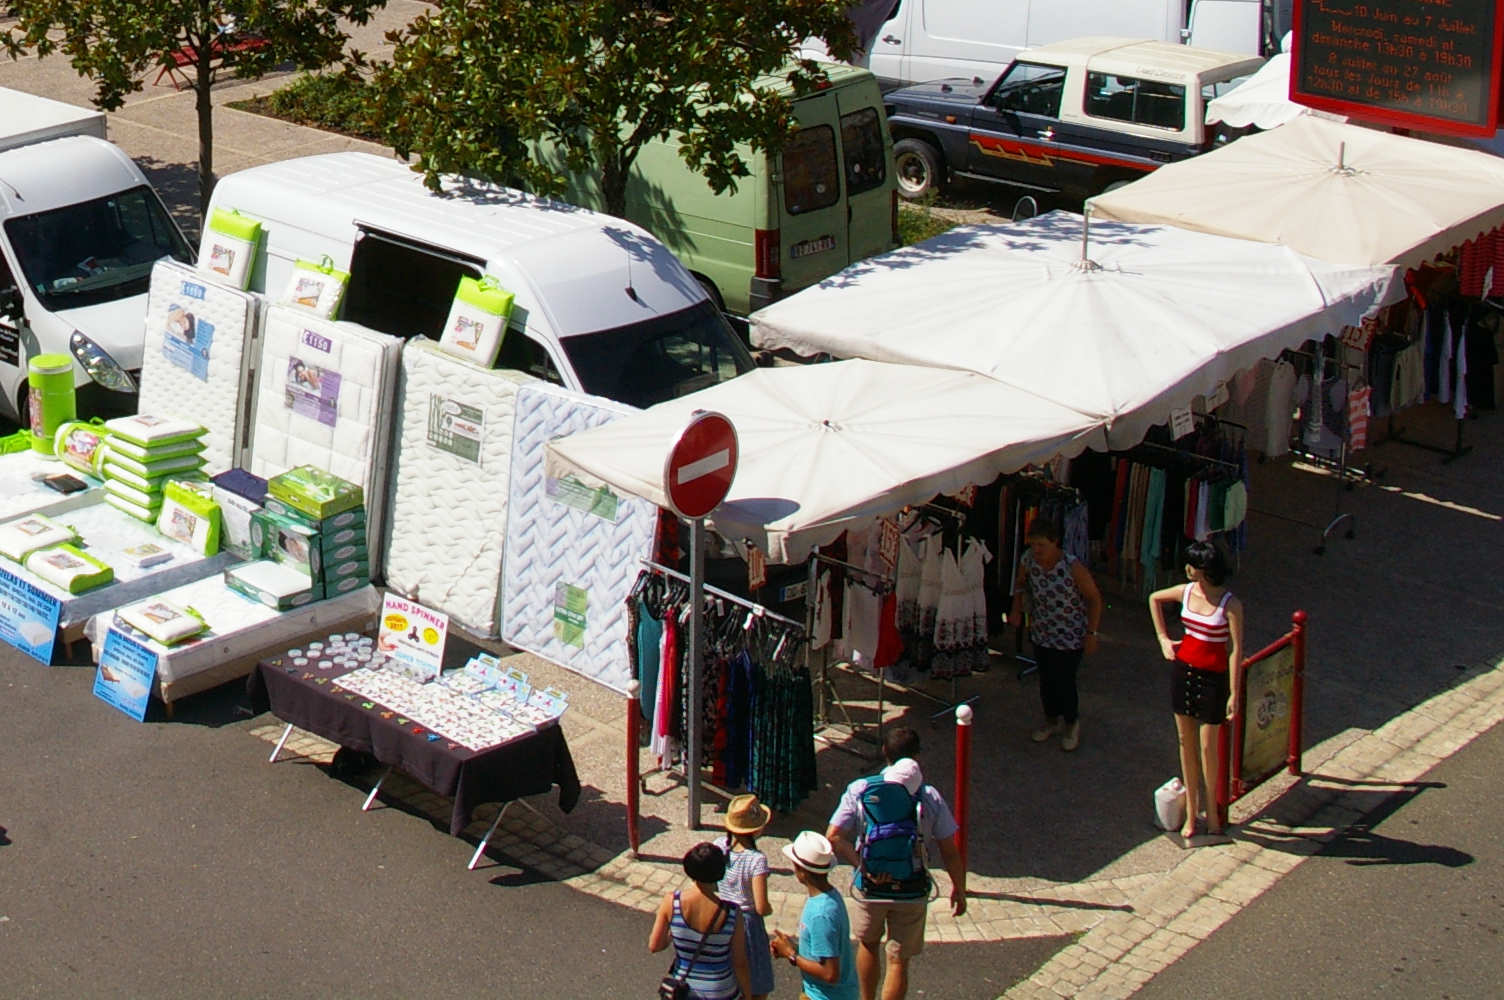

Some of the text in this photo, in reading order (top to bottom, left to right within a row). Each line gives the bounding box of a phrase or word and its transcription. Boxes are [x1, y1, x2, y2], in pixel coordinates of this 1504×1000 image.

[1354, 4, 1368, 18] 10
[1403, 16, 1419, 26] au
[1424, 16, 1433, 28] 7
[1312, 32, 1370, 51] dimanche
[1434, 50, 1473, 68] 19h30
[1441, 39, 1454, 50] et
[1313, 63, 1340, 78] tous
[1345, 68, 1362, 82] les
[1405, 79, 1421, 92] de
[1382, 63, 1399, 75] au
[1404, 65, 1419, 77] 27
[1348, 83, 1360, 95] et
[1365, 86, 1381, 100] de
[18, 577, 26, 591] ET
[26, 582, 58, 608] SOMMIER
[385, 600, 408, 612] HAND
[411, 605, 445, 630] SPINNER
[394, 650, 414, 662] SUPER
